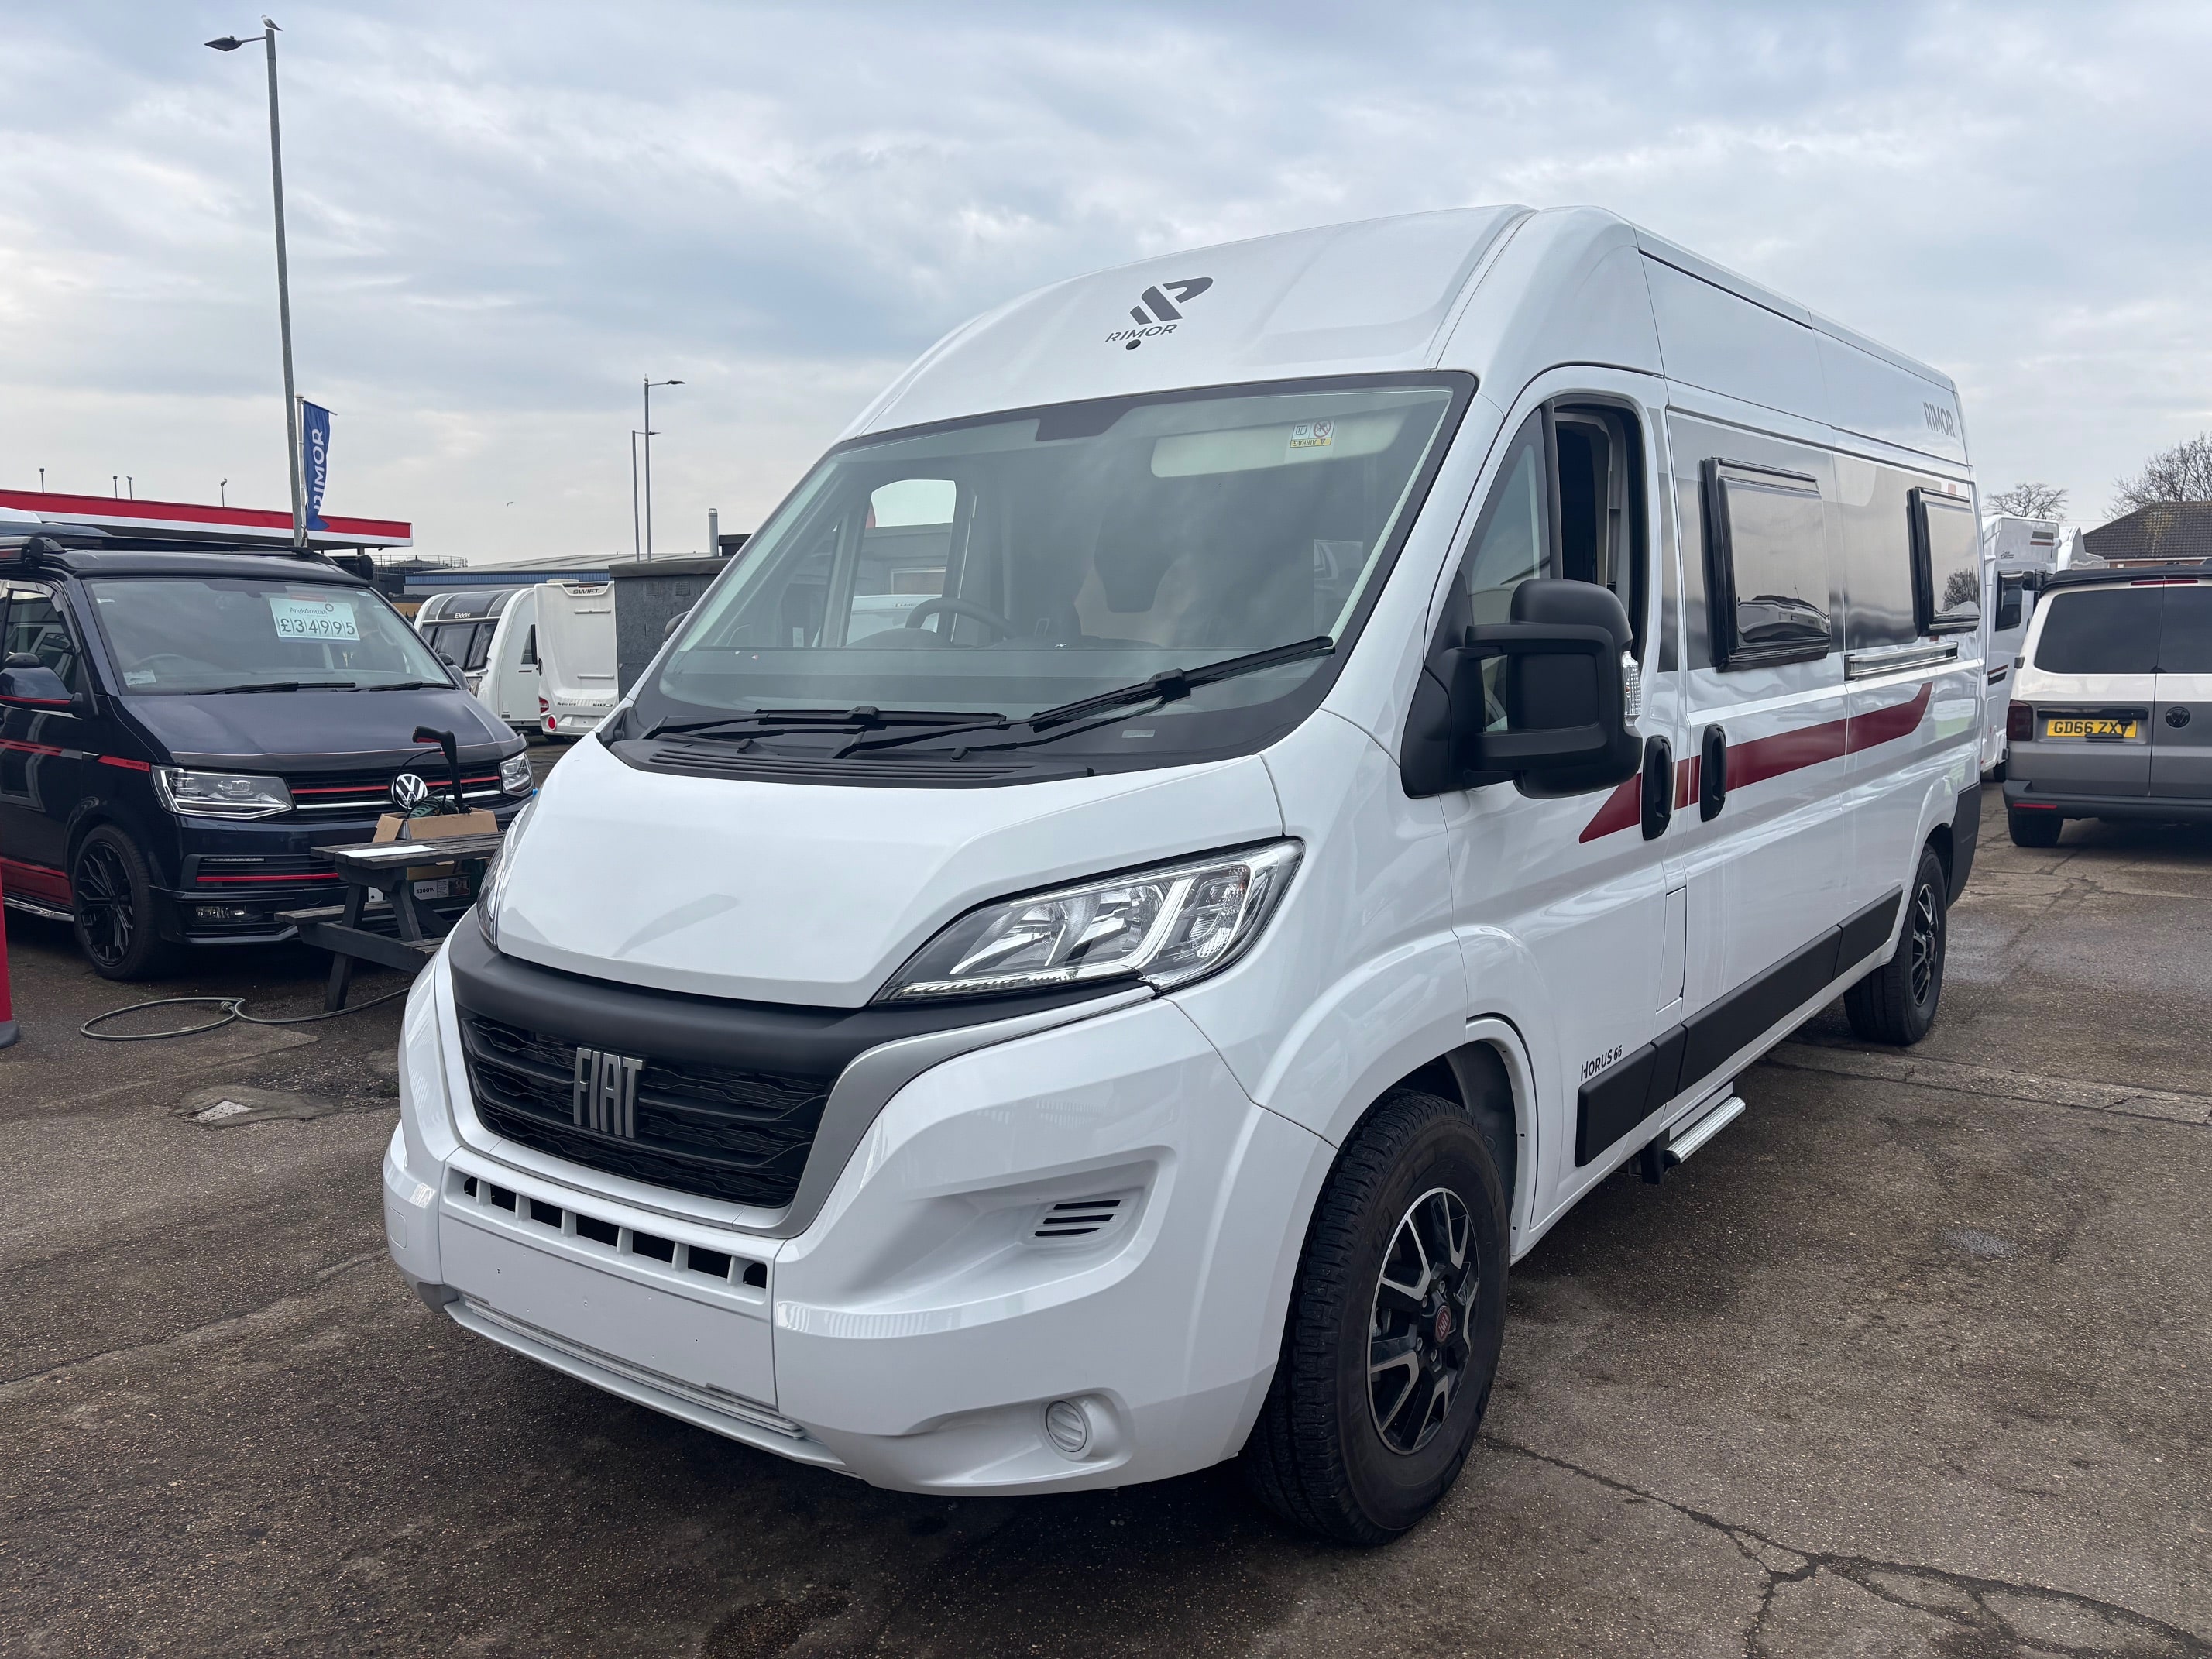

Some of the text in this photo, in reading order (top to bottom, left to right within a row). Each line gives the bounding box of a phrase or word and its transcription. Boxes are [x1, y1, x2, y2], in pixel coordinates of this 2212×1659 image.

[1104, 324, 1177, 342] RIMOR
[1922, 401, 1956, 438] RIMOR
[1293, 438, 1317, 447] AIRBAG
[280, 618, 356, 635] £34995
[2054, 721, 2094, 733] GD66
[1580, 1045, 1623, 1081] HORUS 66
[573, 1047, 644, 1138] FIAT
